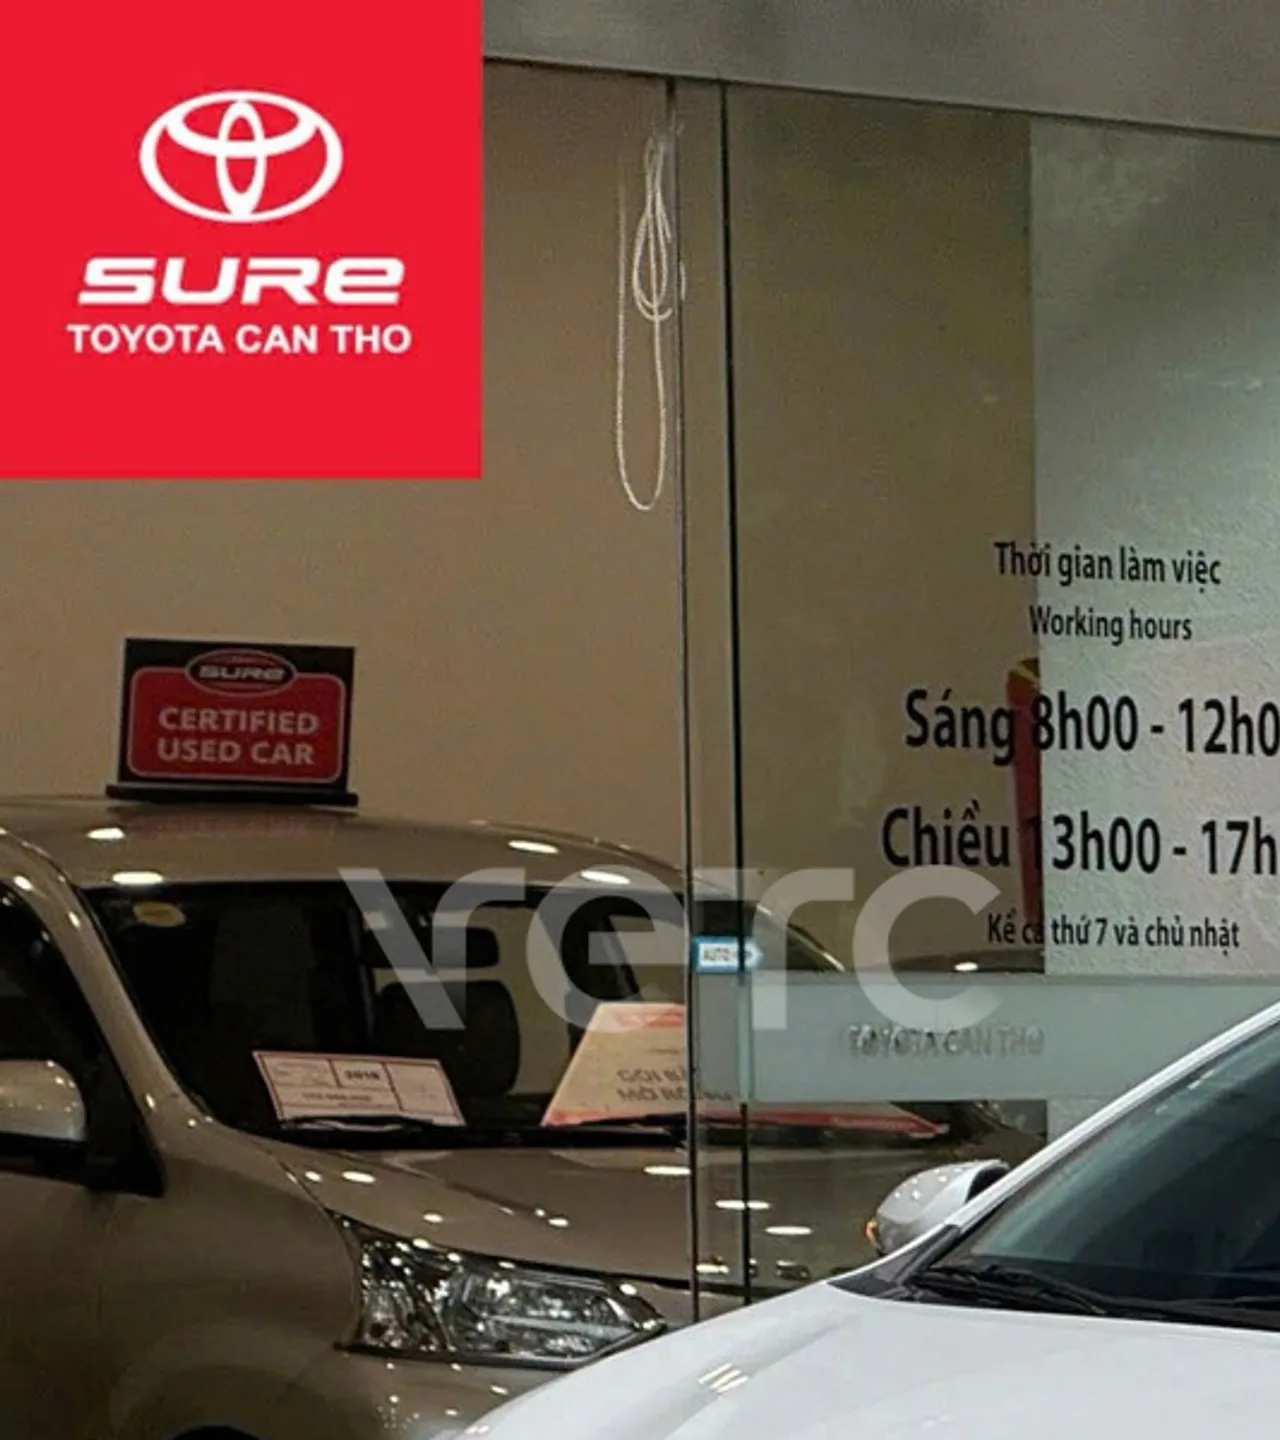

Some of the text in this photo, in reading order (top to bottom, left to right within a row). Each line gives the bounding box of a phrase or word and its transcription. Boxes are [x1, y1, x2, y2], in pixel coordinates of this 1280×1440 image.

[994, 541, 1222, 593] Thời gian làm việc
[1029, 605, 1192, 646] Working hours
[158, 707, 321, 736] CERTIFIED
[905, 688, 1016, 766] Sáng
[1031, 690, 1139, 751] 8h00
[1150, 725, 1164, 735] -
[157, 738, 316, 766] USED CAR
[881, 799, 1011, 868] Chiều
[1025, 810, 1161, 875] 13h00
[1172, 846, 1187, 857] -
[1051, 914, 1090, 946] thứ
[1096, 917, 1108, 946] 7
[1114, 917, 1139, 947] và
[1145, 914, 1184, 947] chủ
[1190, 916, 1240, 956] nhật
